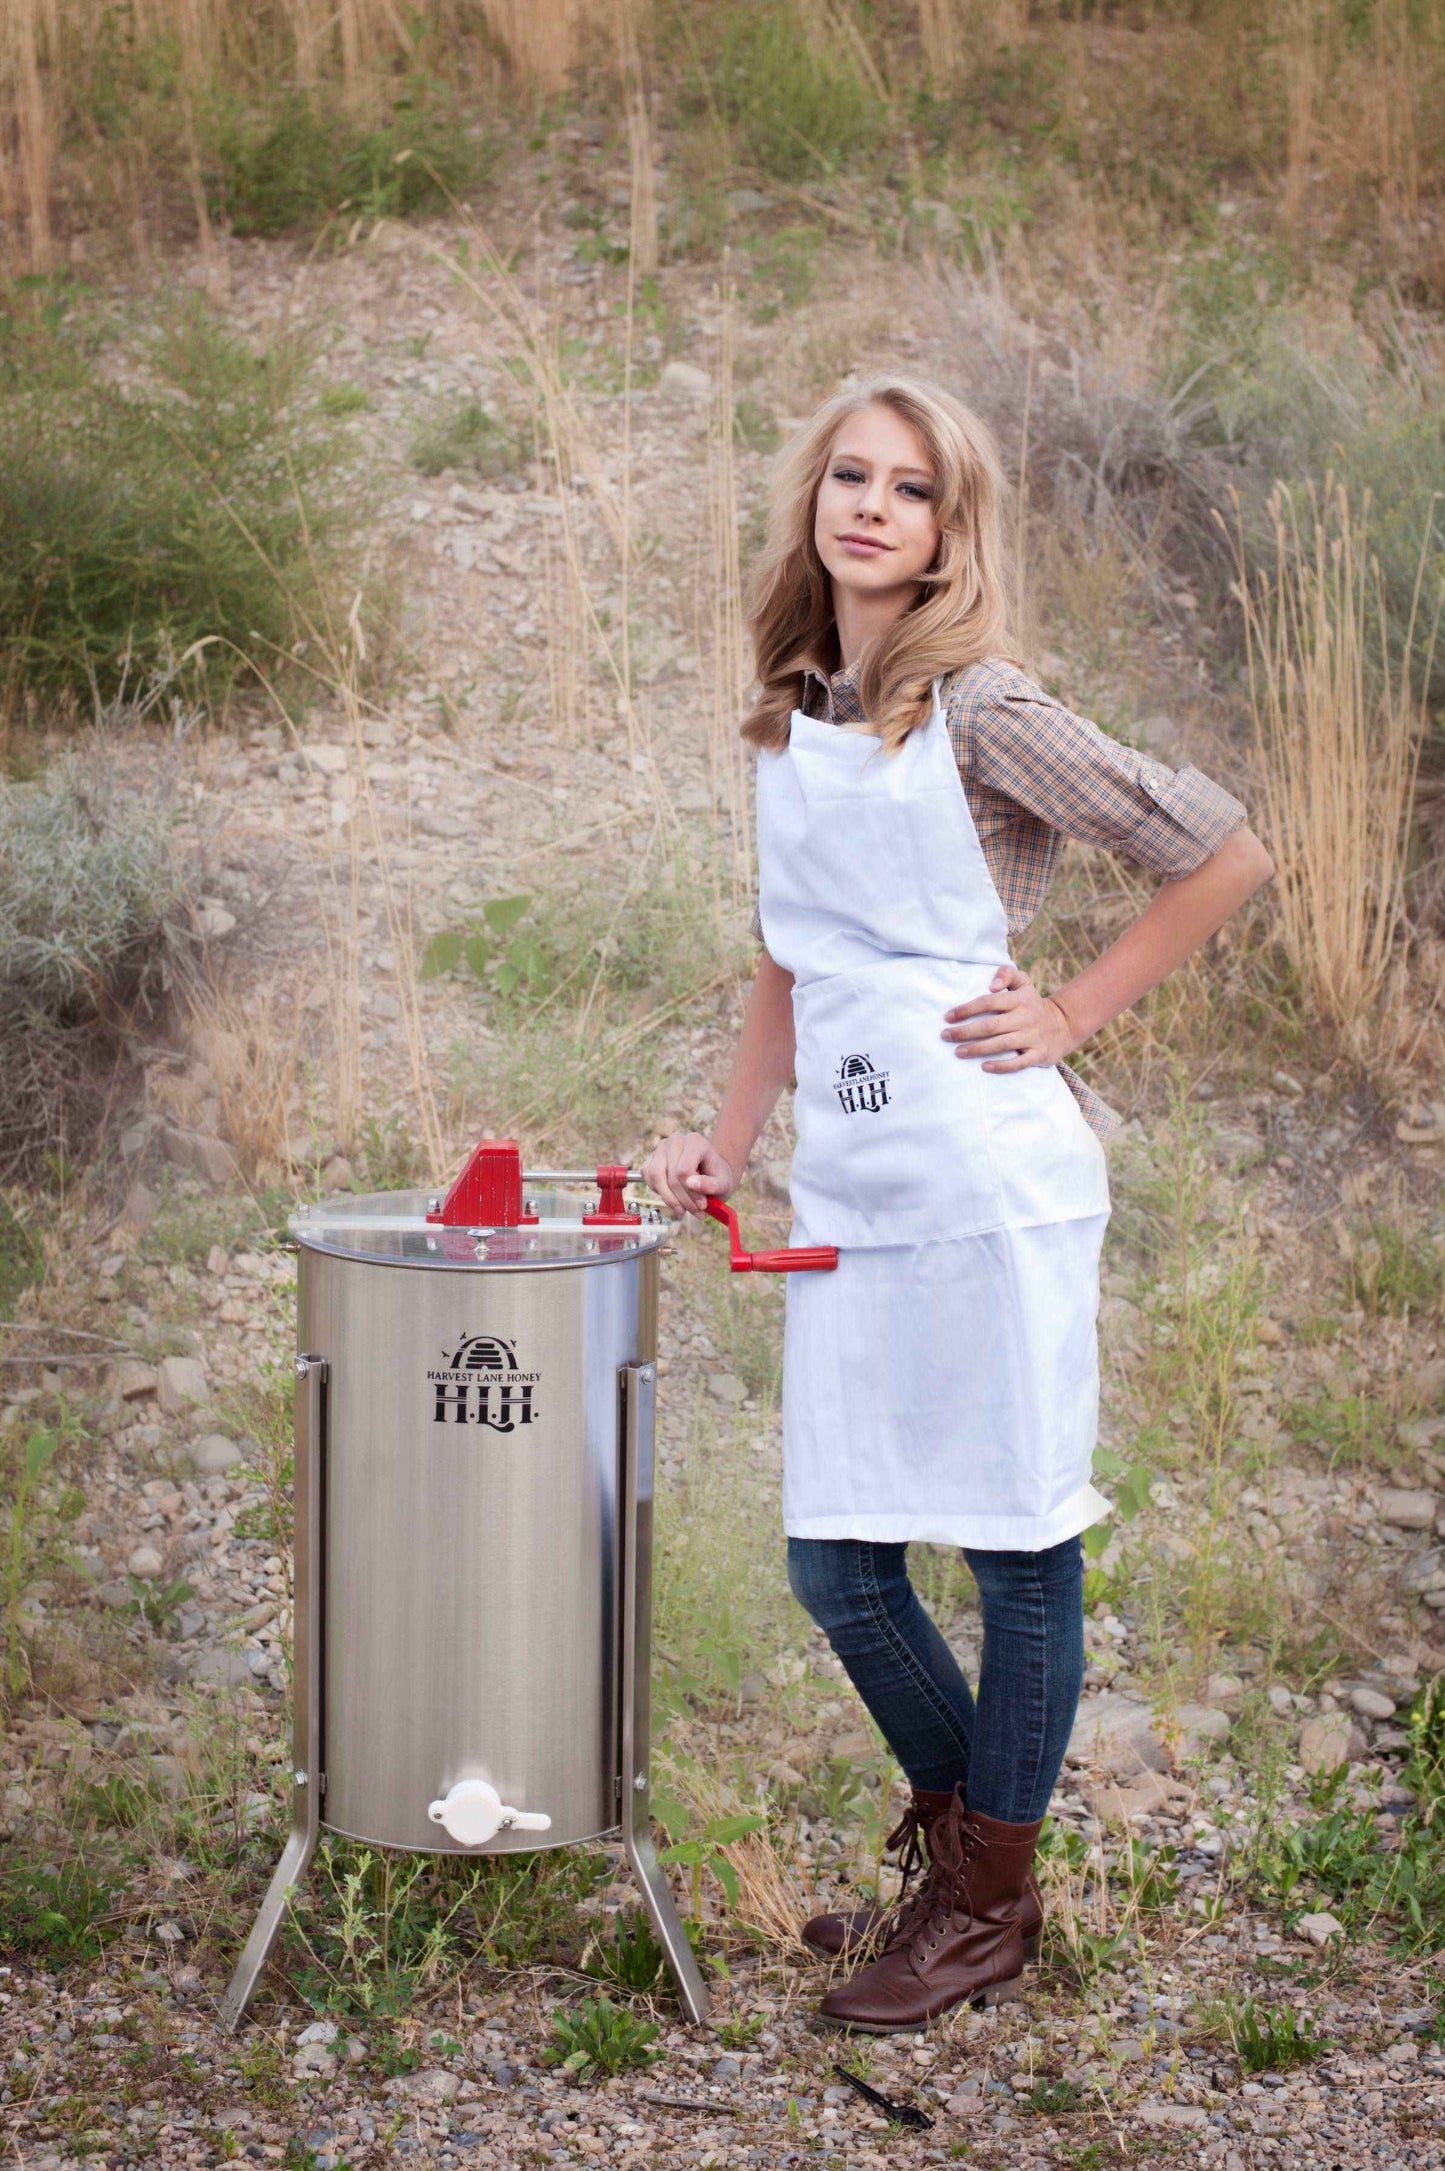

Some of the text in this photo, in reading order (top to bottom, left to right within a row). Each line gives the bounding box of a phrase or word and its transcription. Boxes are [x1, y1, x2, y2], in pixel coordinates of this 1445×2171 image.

[869, 1071, 889, 1080] HONEY
[427, 1370, 542, 1382] HARVEST LANE HONEY
